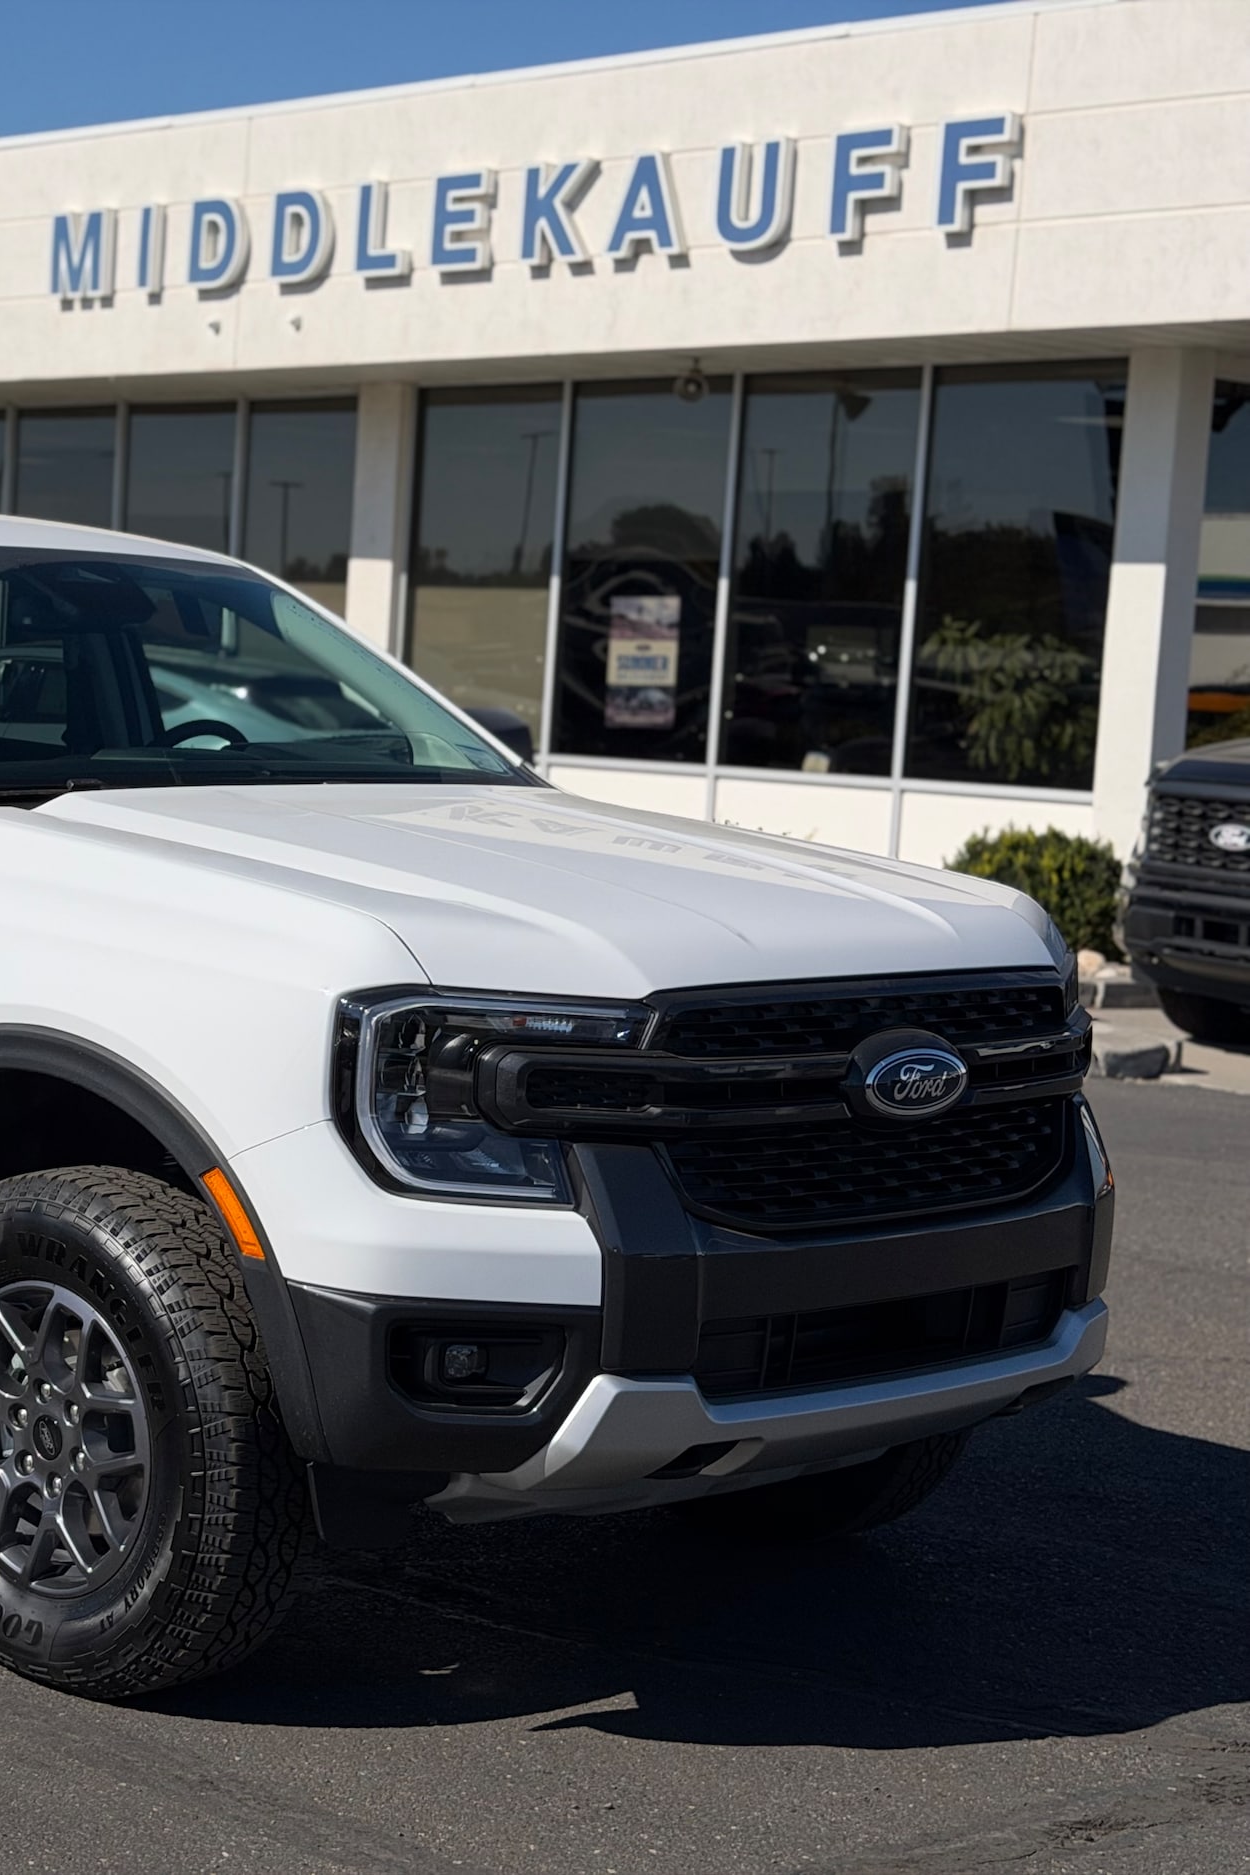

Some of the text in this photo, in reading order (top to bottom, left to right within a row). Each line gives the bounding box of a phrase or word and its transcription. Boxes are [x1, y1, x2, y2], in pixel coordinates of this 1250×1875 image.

[50, 112, 1021, 299] MIDDLEKAUFF
[893, 1063, 947, 1100] Ford
[14, 1231, 166, 1410] WRANGLER
